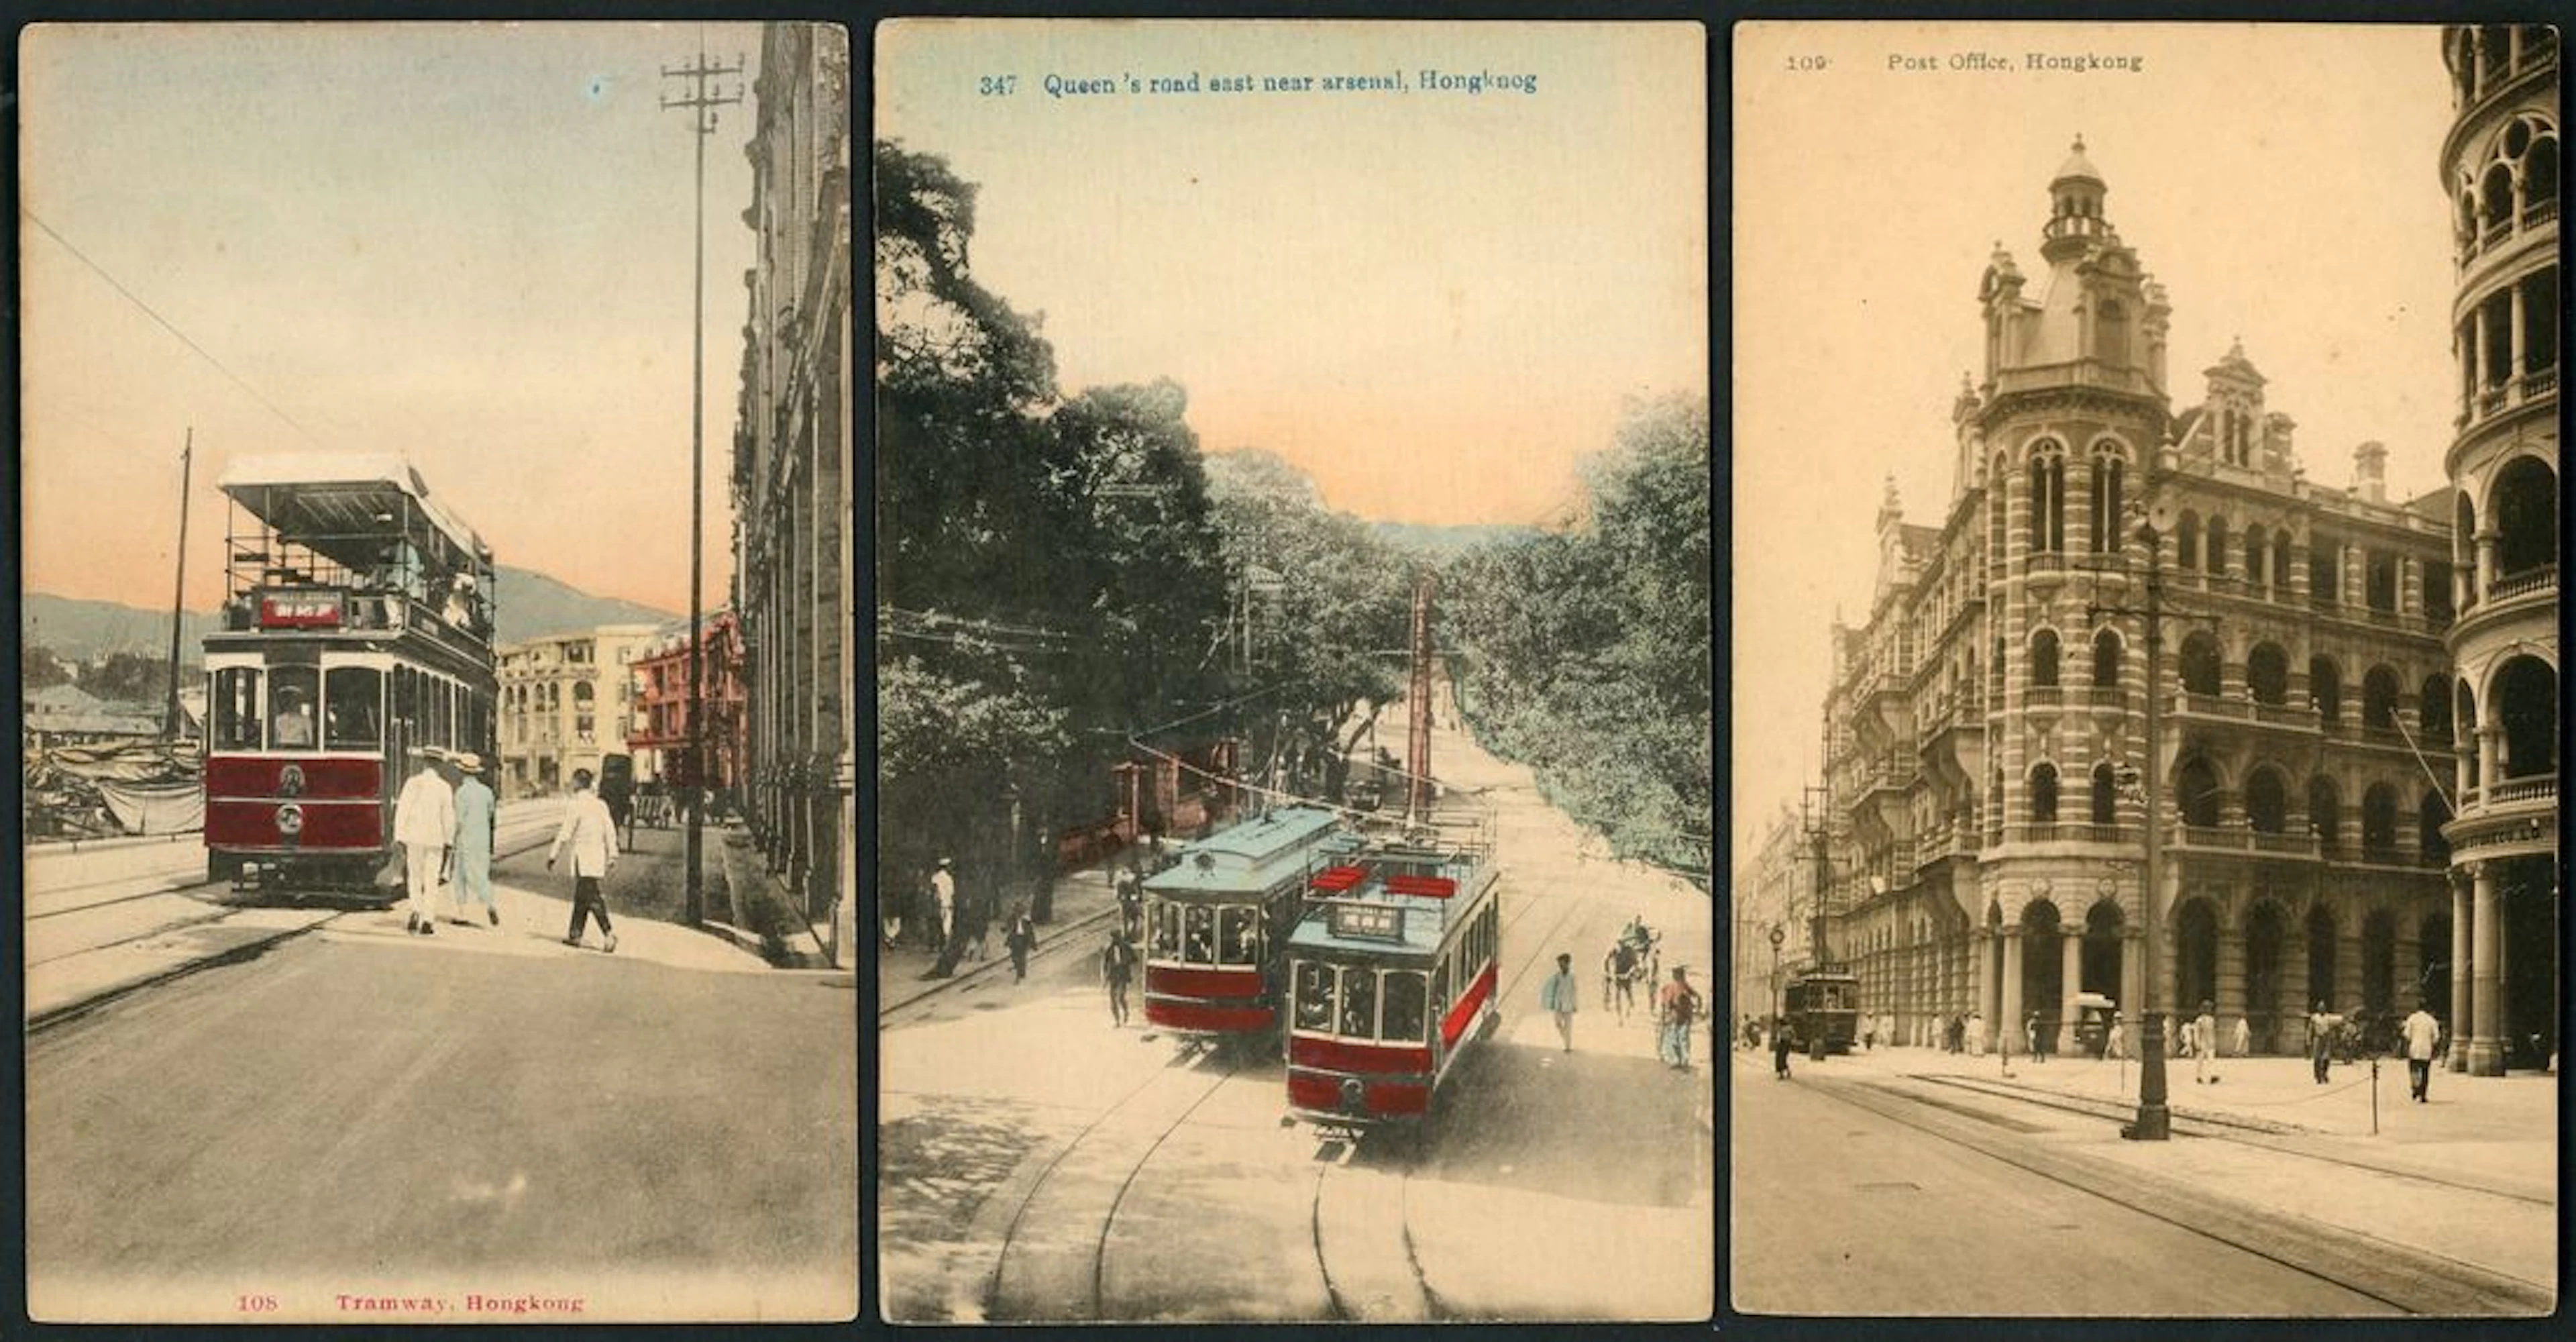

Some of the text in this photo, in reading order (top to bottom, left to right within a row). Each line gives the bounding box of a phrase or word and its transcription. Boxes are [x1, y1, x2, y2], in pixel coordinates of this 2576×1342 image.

[1888, 54, 1937, 70] Post
[1948, 52, 2015, 72] Office,
[2025, 52, 2144, 73] Hongkong
[979, 75, 1018, 96] 347
[1043, 73, 1116, 99] Queen
[1149, 71, 1201, 94] road
[1209, 74, 1255, 94] east
[1263, 76, 1314, 93] near
[1322, 69, 1409, 94] arsenal,
[1419, 68, 1538, 95] Hongknog
[239, 1294, 584, 1314] 108 Tramway, Hongkong
